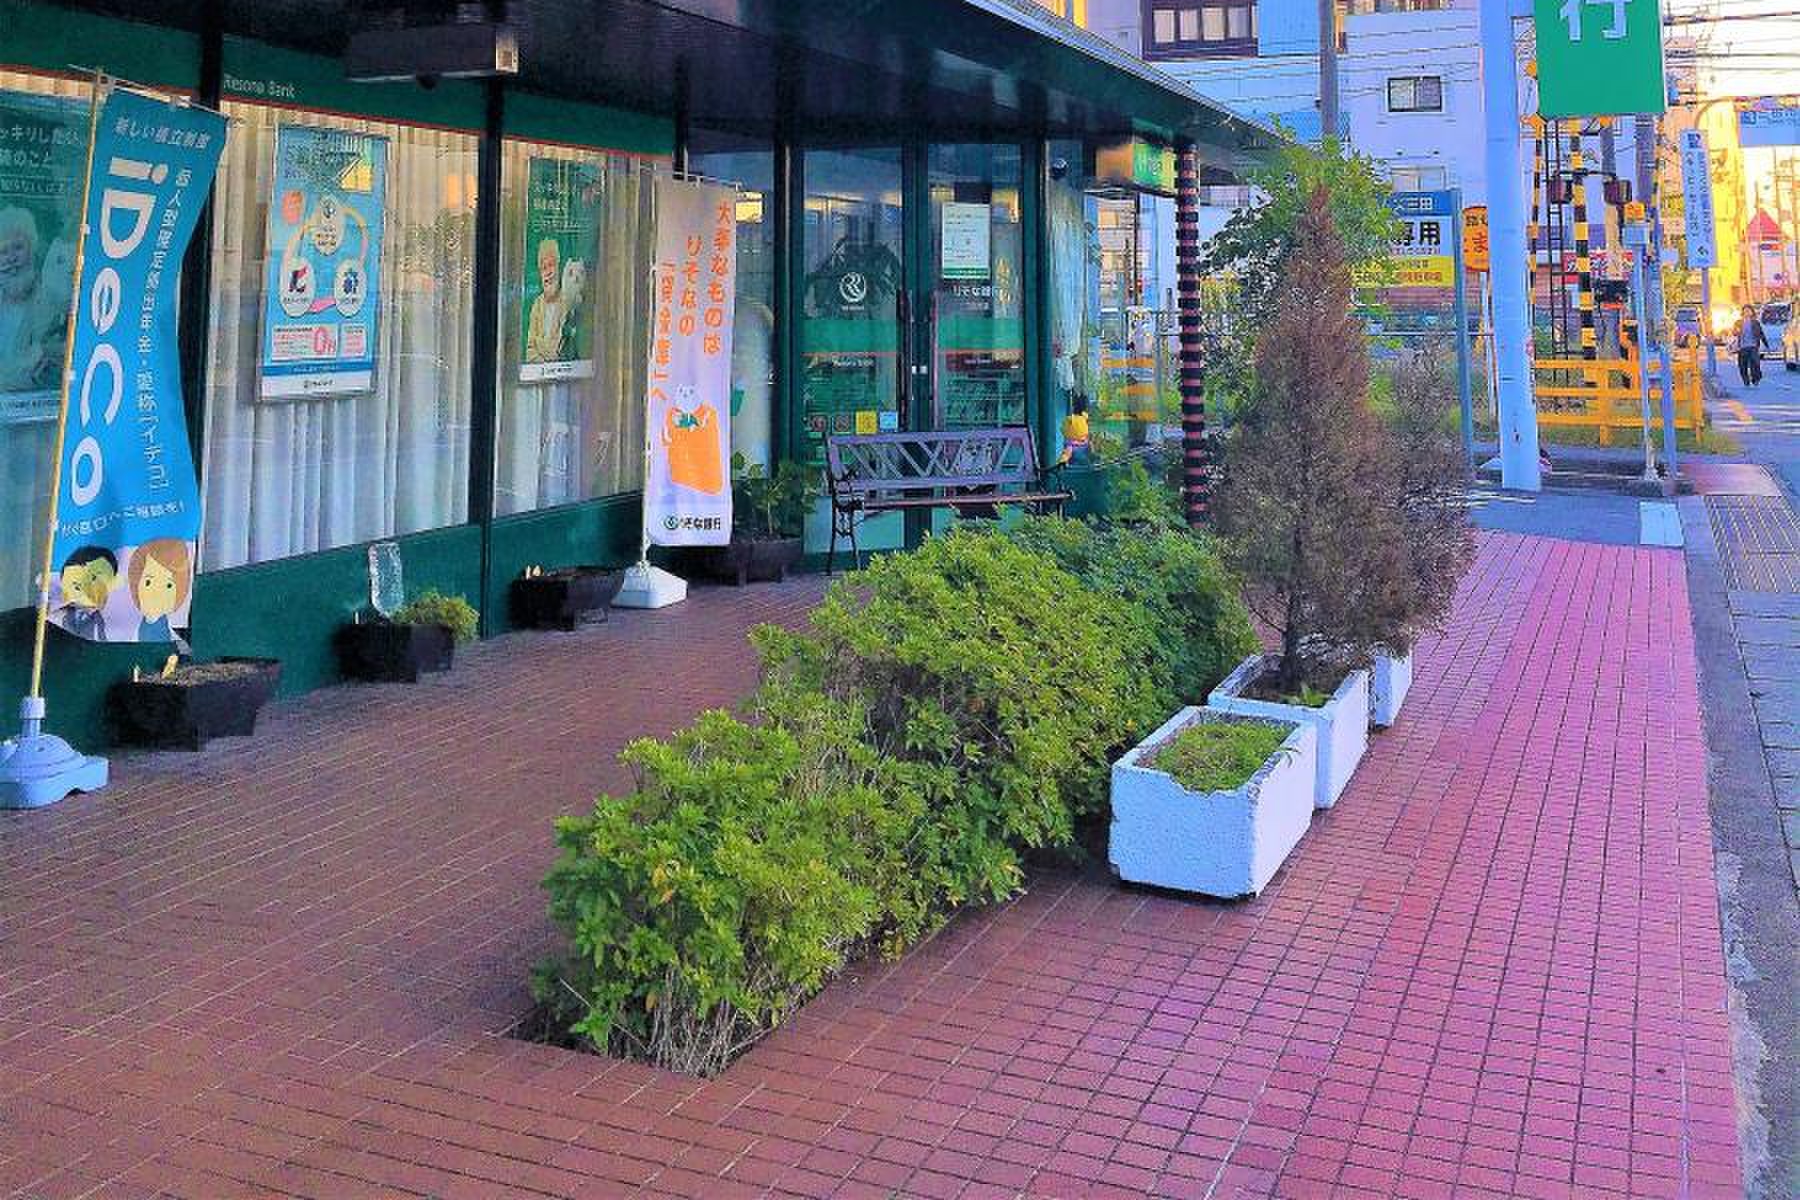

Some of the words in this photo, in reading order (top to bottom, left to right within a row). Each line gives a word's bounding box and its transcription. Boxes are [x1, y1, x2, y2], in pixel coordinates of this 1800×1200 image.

[71, 156, 169, 506] iDeCo
[678, 234, 703, 336] りそなの
[703, 201, 731, 357] 大事なものは
